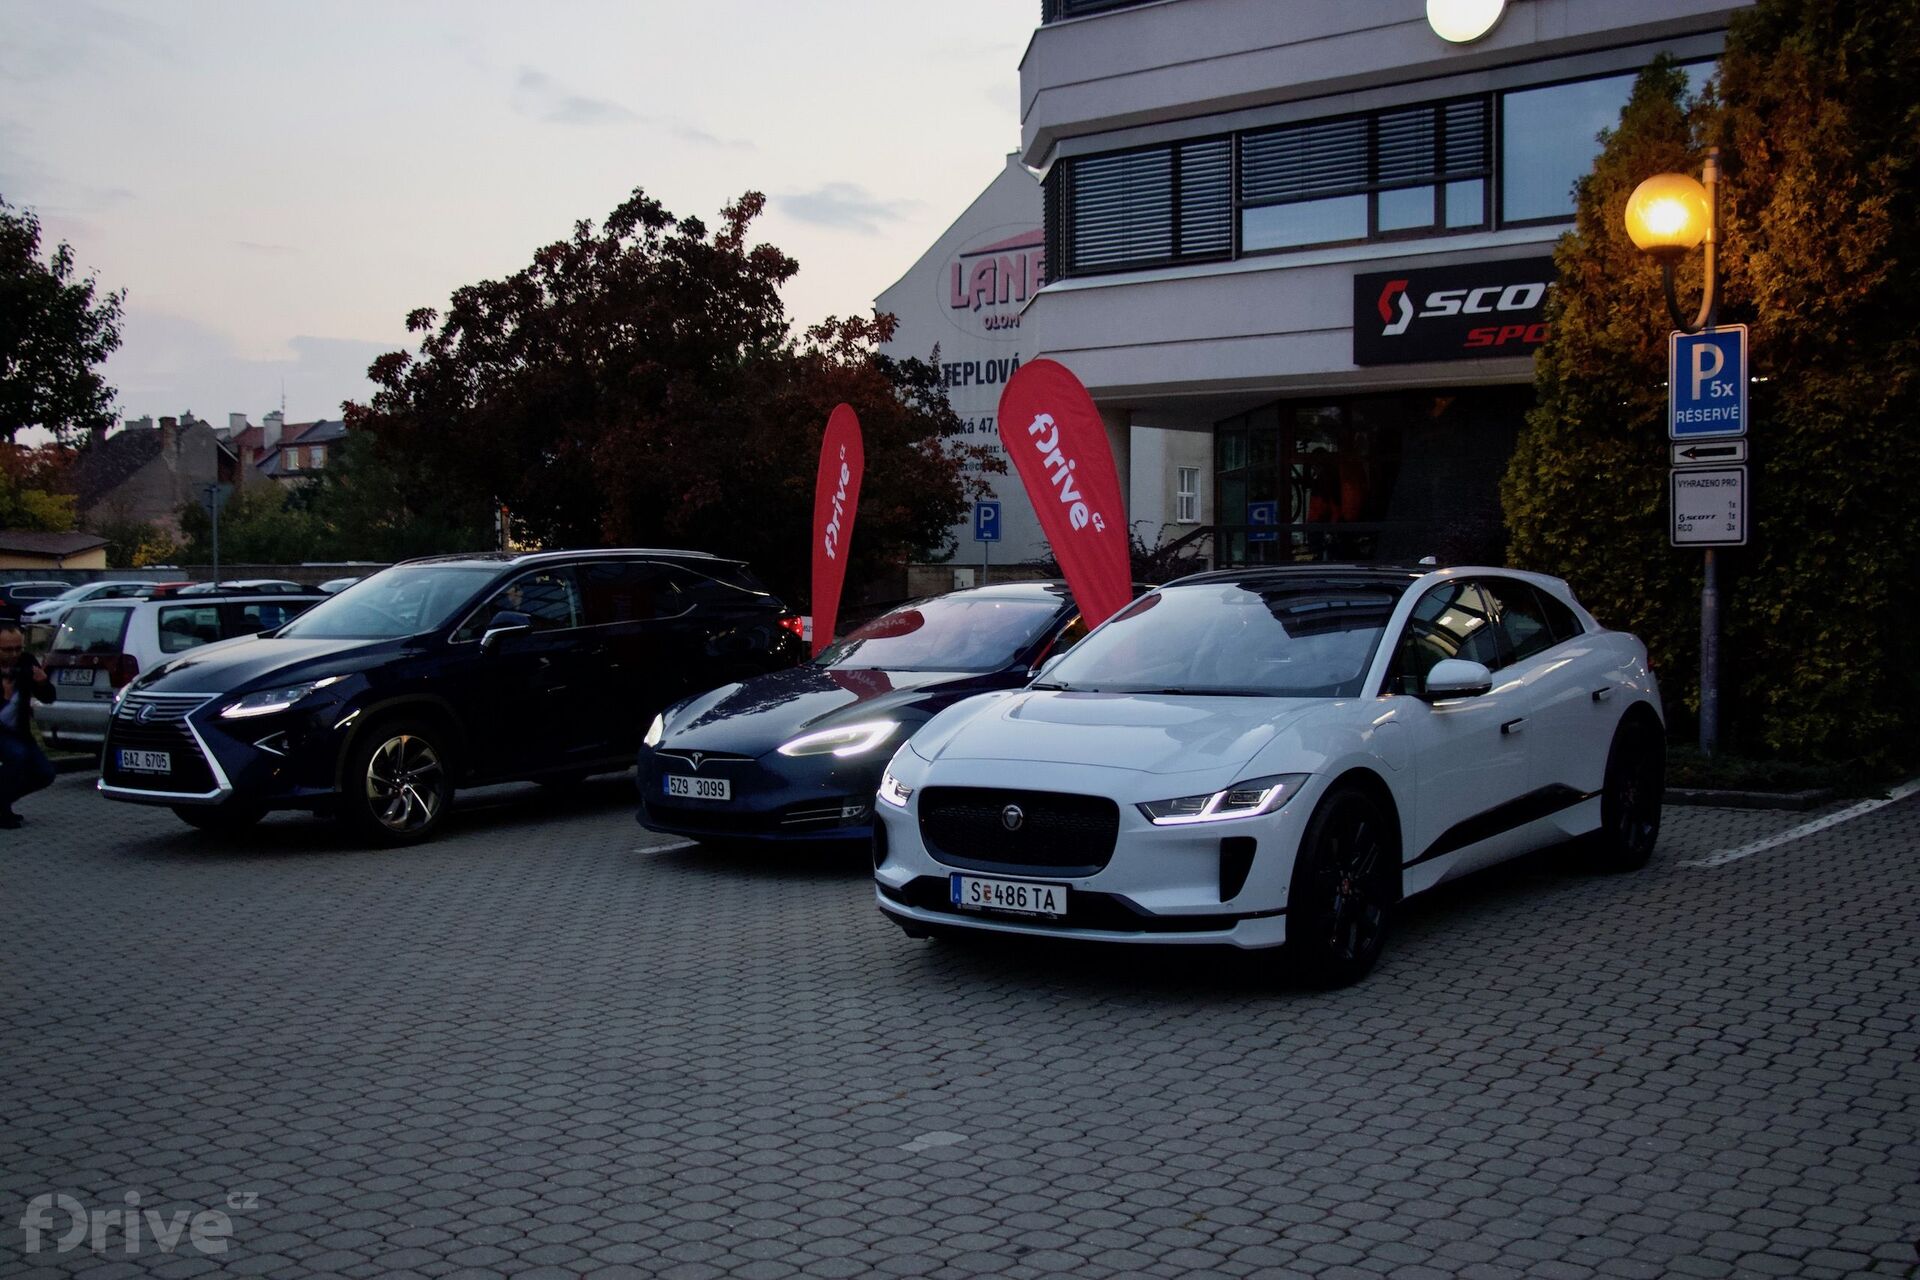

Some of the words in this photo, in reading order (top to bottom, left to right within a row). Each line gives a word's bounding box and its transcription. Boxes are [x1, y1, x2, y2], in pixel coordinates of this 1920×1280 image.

[1418, 282, 1556, 318] SCO
[1692, 343, 1724, 400] P
[1710, 381, 1734, 398] 5x
[1676, 404, 1739, 423] RÉSERVÉ
[980, 507, 995, 528] P
[124, 752, 139, 766] 6AZ
[145, 753, 167, 768] 6705
[670, 778, 688, 794] 5Z9
[697, 780, 724, 797] 3099
